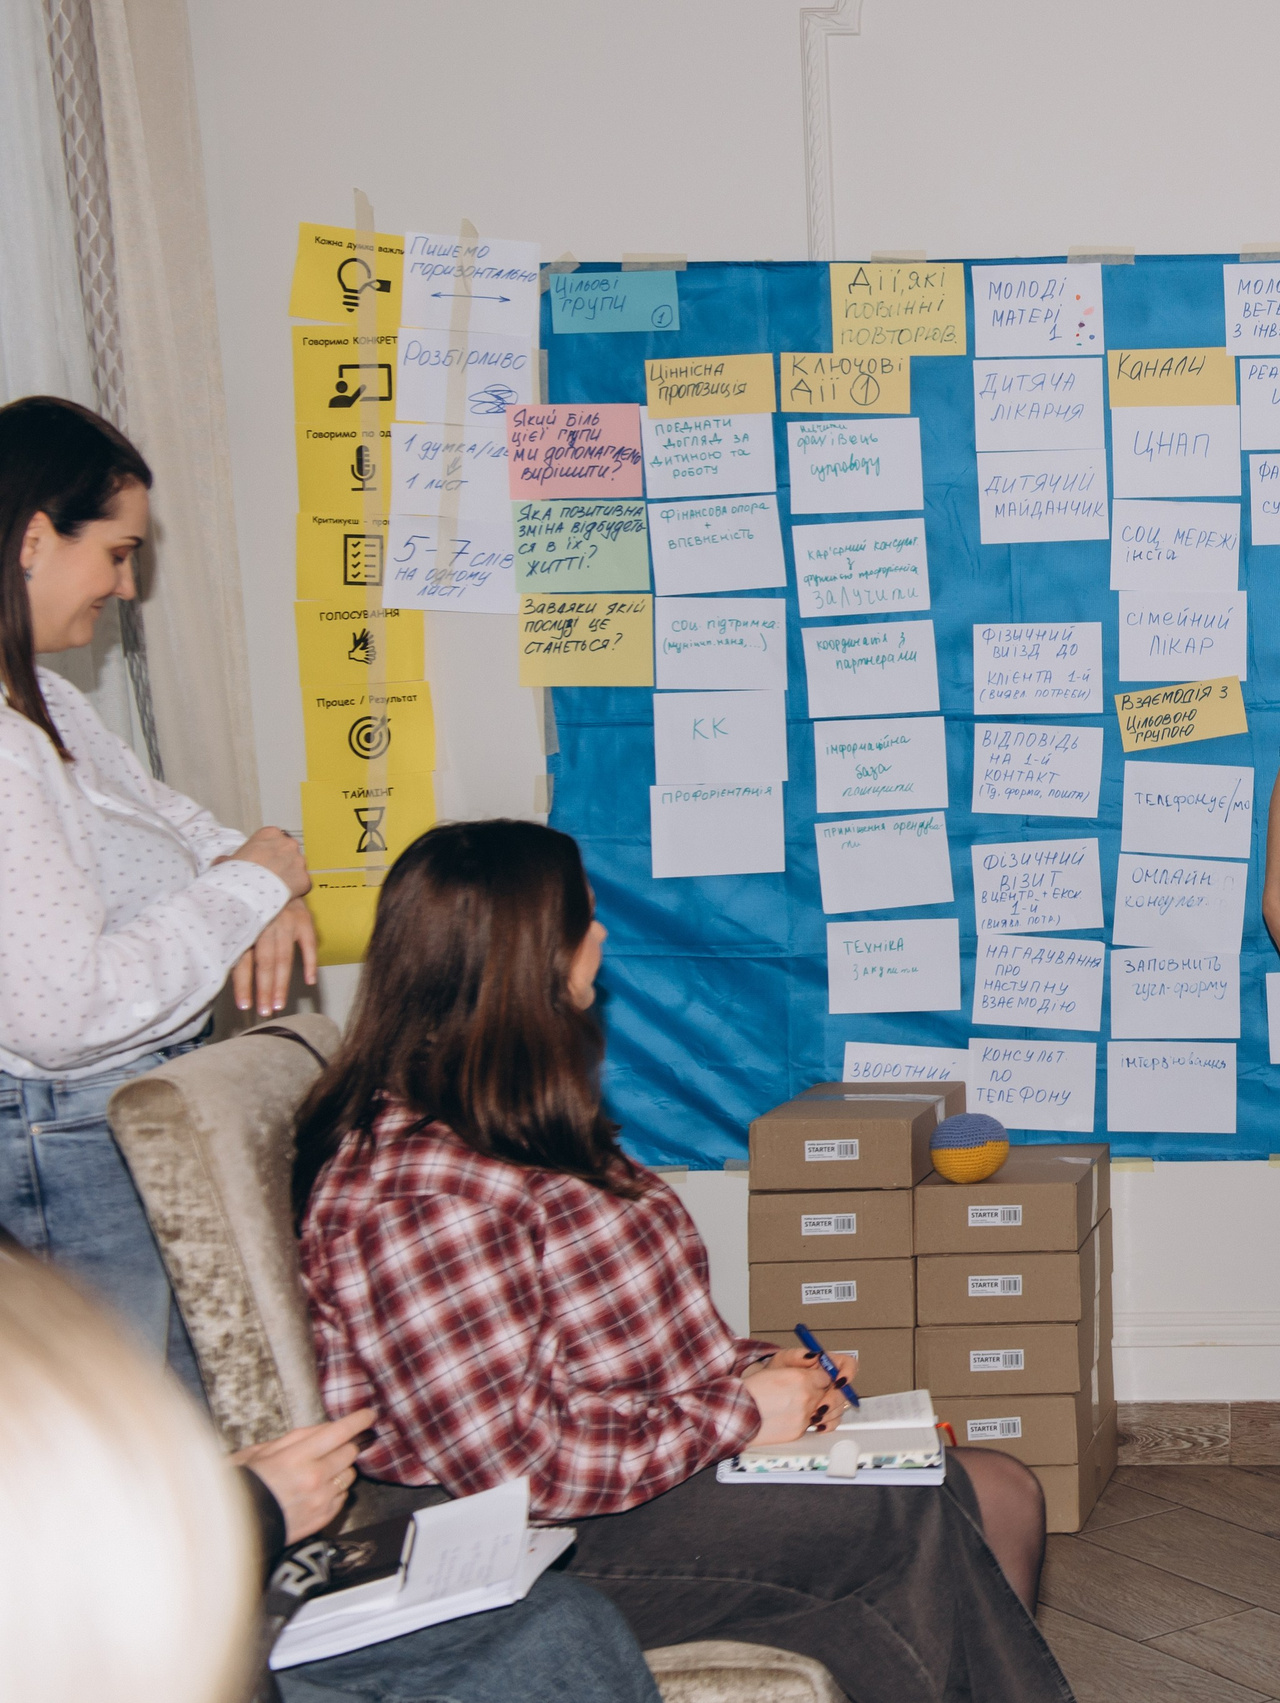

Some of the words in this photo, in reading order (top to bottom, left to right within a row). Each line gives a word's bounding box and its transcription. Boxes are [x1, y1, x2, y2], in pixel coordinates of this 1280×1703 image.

[346, 241, 374, 252] думка
[555, 275, 619, 299] Цільові
[988, 277, 1067, 302] МОЛОДІ
[561, 294, 627, 321] групи
[992, 303, 1062, 328] МАТЕРІ
[302, 335, 350, 348] Говоримо
[352, 334, 399, 346] КОНКРЕТ
[650, 361, 726, 387] Ціннісна
[658, 379, 748, 406] пропозиція
[979, 372, 1076, 401] ДИТЯЧА
[513, 407, 557, 428] Який
[990, 402, 1085, 423] ЛІКАРНЯ
[306, 429, 357, 441] Говоримо
[361, 430, 375, 438] по
[404, 433, 418, 452] 1
[662, 432, 723, 450] догляд
[1133, 430, 1211, 462] ЦНАП
[649, 450, 723, 469] дитиною
[406, 473, 420, 490] 1
[672, 464, 719, 480] роботу
[984, 465, 1096, 496] ДИТЯЧИЙ
[731, 501, 770, 516] опора
[994, 498, 1105, 520] МАЙДАНЧИК
[1173, 527, 1239, 551] МЕРЕЖІ
[319, 608, 400, 621] ГОЛОСУВАННЯ
[523, 598, 598, 615] Завдяки
[1055, 643, 1079, 660] ДО
[1149, 632, 1215, 657] ЛІКАР
[316, 696, 355, 709] Процес
[368, 693, 418, 705] Результат
[981, 729, 1079, 752] ВІДПОВІДЬ
[989, 752, 1013, 766] НА
[983, 769, 1061, 785] КОНТАКТ
[342, 786, 394, 799] ТАЙМІНГ
[983, 846, 1088, 871] ФІЗИЧНИЙ
[1000, 870, 1063, 892] ВІЗИТ
[1131, 866, 1214, 887] ОНЛАЙН
[986, 944, 1102, 968] НАГАДУВАННЯ
[1124, 955, 1222, 975] ЗАПОВНИТЬ
[995, 963, 1021, 977] ПРО
[983, 979, 1069, 997] НАСТУПНУ
[981, 994, 1077, 1015] ВЗАЄМОДІЮ
[850, 1061, 957, 1081] ЗВОРОТНИЙ
[989, 1068, 1013, 1084] ПО
[976, 1085, 1074, 1107] ТЕЛЕФОНУ
[807, 1146, 836, 1154] STARTER
[804, 1220, 833, 1228] STARTER
[971, 1211, 999, 1219] STARTER
[804, 1288, 833, 1296] STARTER
[971, 1281, 999, 1289] STARTER
[972, 1356, 1001, 1364] STARTER
[970, 1424, 998, 1433] STARTER
